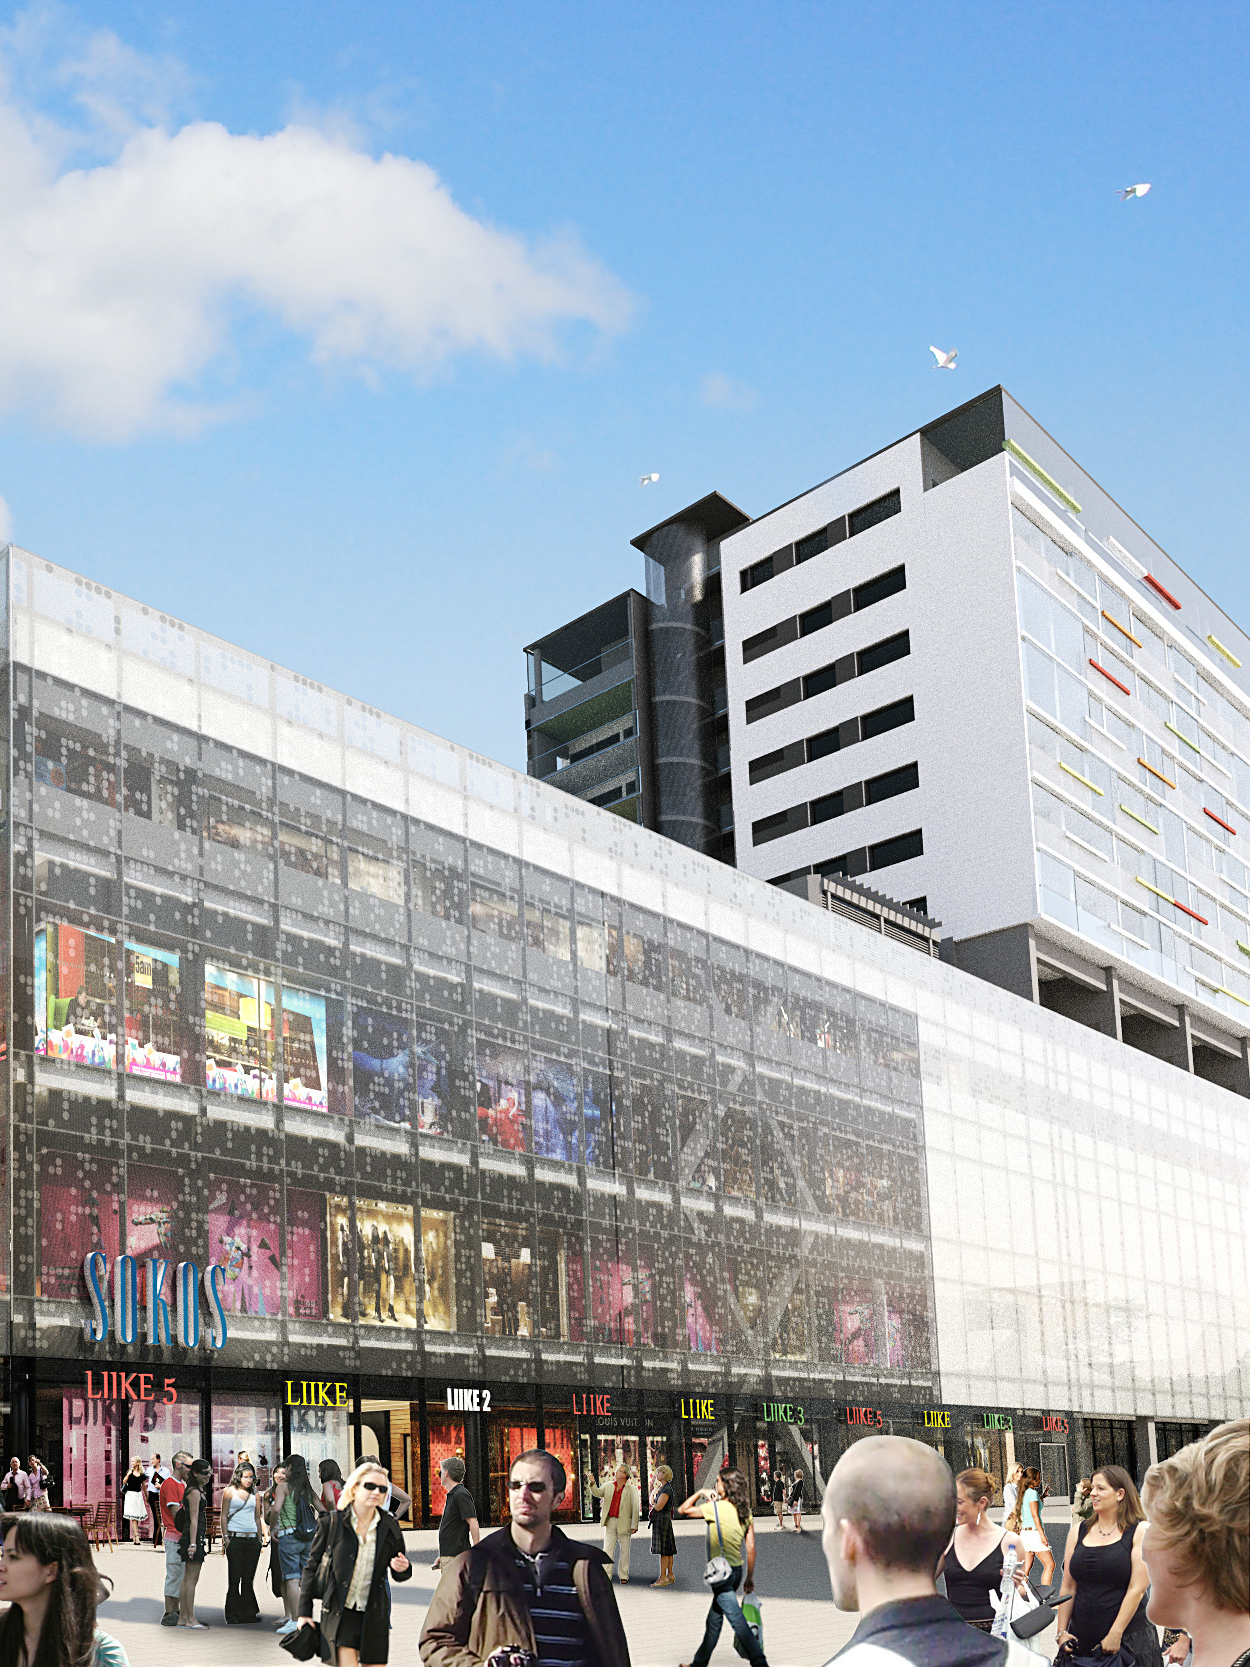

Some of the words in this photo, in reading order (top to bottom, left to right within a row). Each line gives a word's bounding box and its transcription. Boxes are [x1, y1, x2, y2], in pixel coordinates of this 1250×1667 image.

[84, 1252, 227, 1350] SOKOS
[85, 1370, 155, 1401] LIIKE
[162, 1377, 178, 1405] 5
[284, 1380, 349, 1407] LIIKE
[447, 1387, 480, 1411] LIIKE
[482, 1389, 491, 1412] 2
[572, 1393, 611, 1416] LIIKE
[681, 1399, 715, 1419] LIIKE
[596, 1417, 618, 1427] OUIS
[620, 1418, 654, 1428] VUITN
[763, 1403, 794, 1423] LIIKE
[797, 1407, 804, 1426] 3
[846, 1407, 874, 1425] LIIKE
[876, 1411, 883, 1428] 5
[924, 1411, 951, 1428] LIIKE
[983, 1414, 1006, 1430] LIIKE
[1007, 1416, 1013, 1432] 3
[1042, 1416, 1063, 1432] LIIKE
[1064, 1419, 1069, 1434] 5
